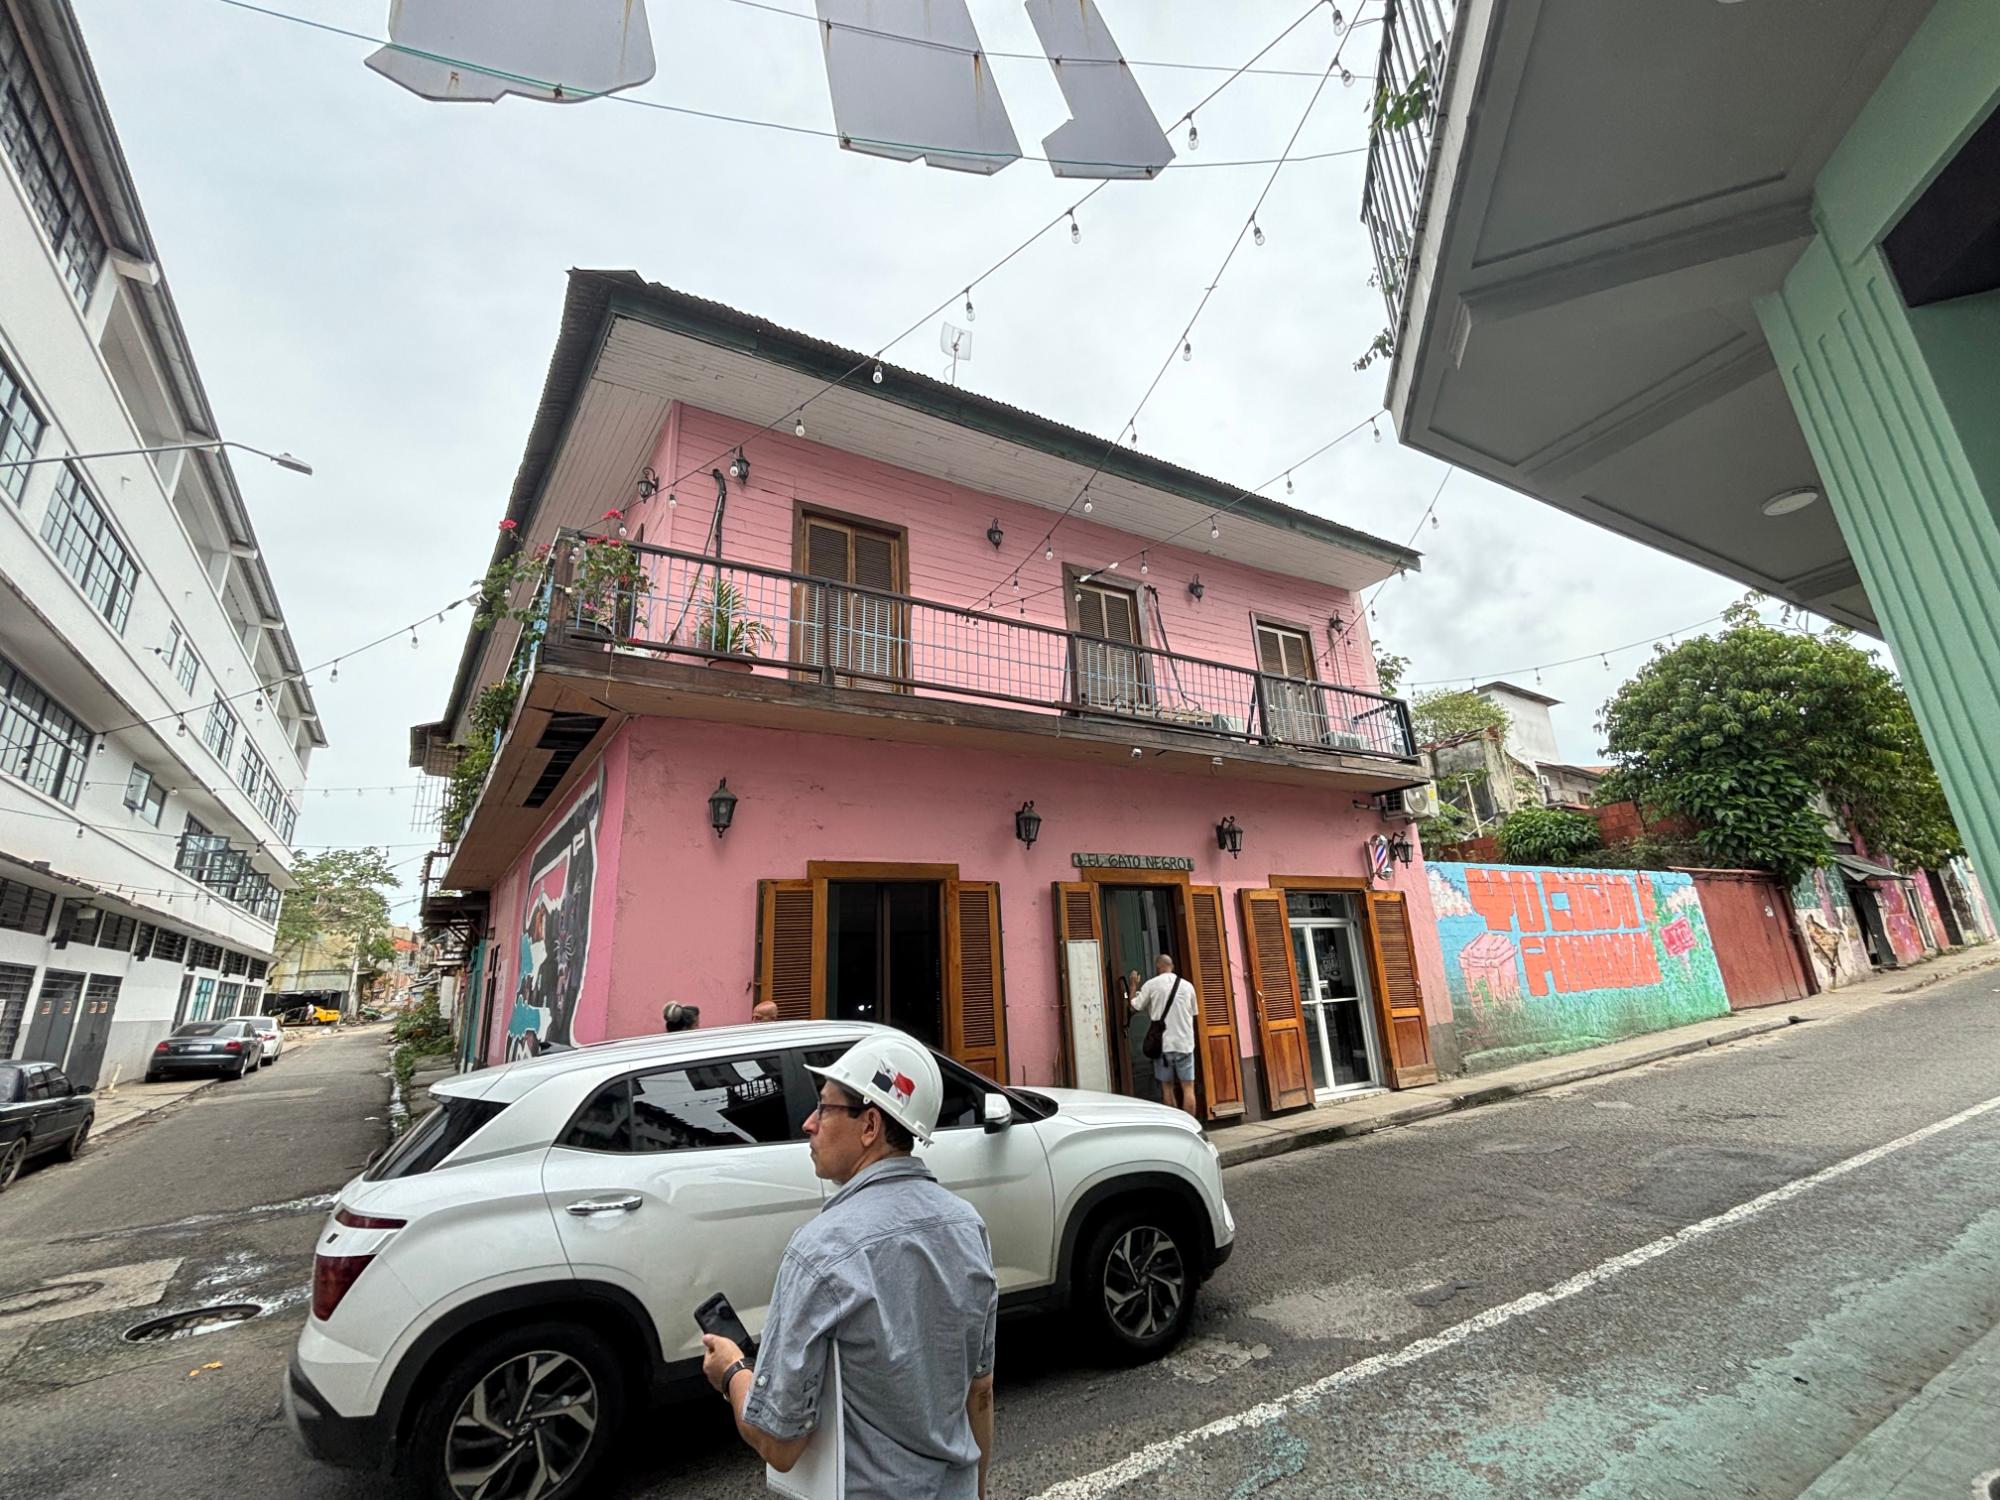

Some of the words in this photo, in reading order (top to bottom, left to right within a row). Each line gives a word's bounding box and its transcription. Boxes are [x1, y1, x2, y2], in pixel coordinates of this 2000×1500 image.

[1087, 854, 1103, 867] EL
[1108, 854, 1141, 868] GATO
[1145, 856, 1186, 870] NEGRO
